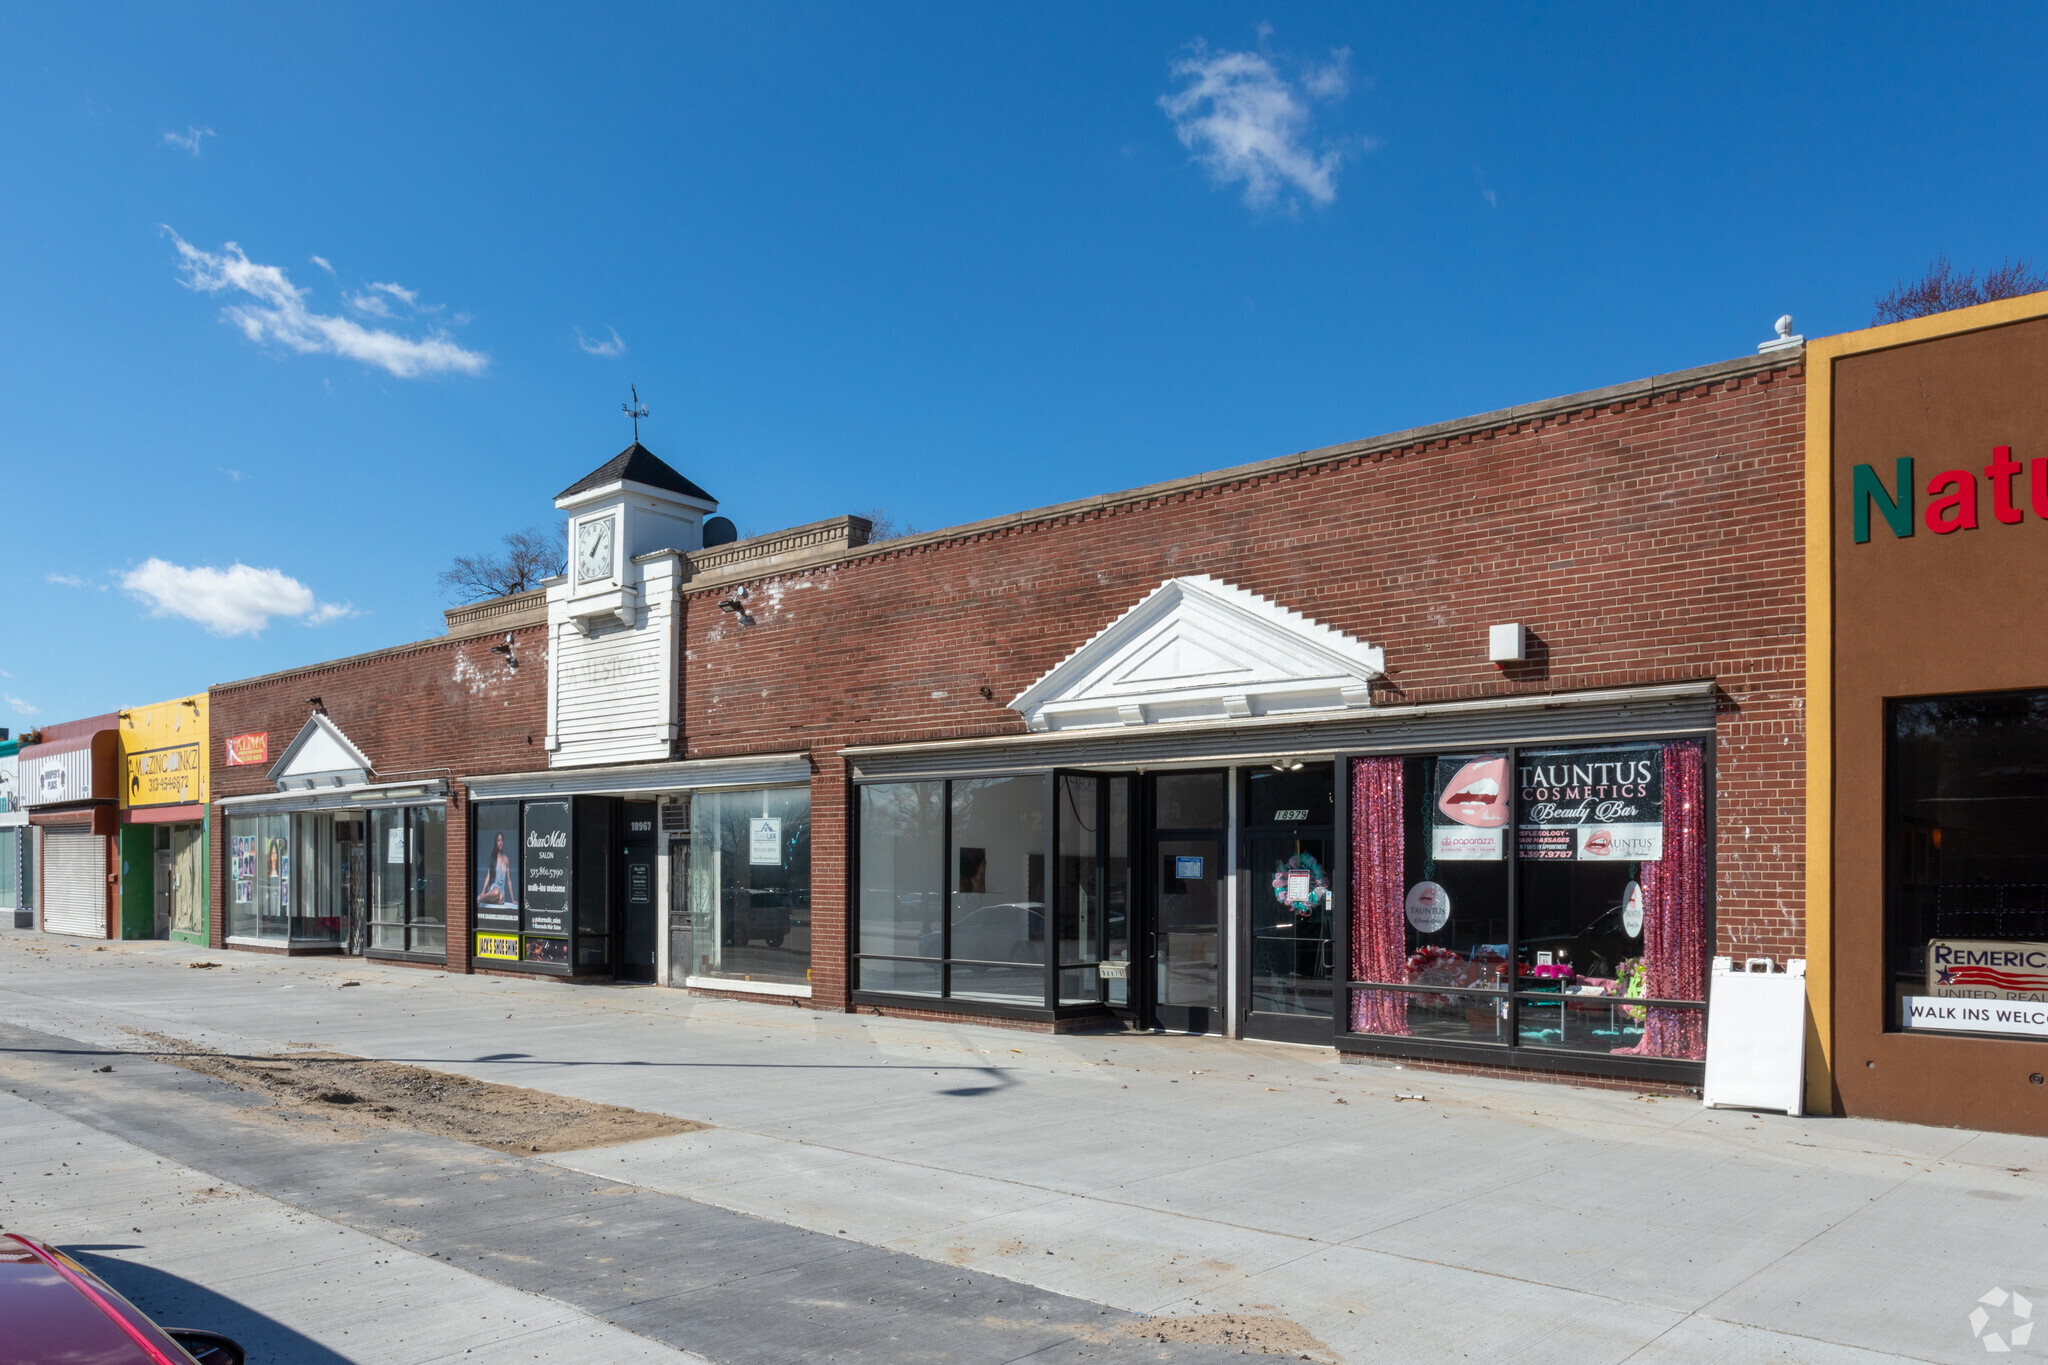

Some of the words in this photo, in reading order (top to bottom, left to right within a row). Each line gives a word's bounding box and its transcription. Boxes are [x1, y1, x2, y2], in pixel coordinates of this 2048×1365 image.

[1520, 761, 1651, 788] TAUNTUS
[1522, 784, 1646, 801] COSMETICS
[1278, 811, 1307, 820] 18979
[1530, 797, 1599, 826] Beauty
[1594, 801, 1638, 823] Bar
[631, 822, 651, 831] 18967
[1600, 838, 1652, 848] TAUNTUS
[547, 884, 566, 893] welcome
[1411, 907, 1446, 915] TAUNTUS
[1935, 945, 2048, 968] REMERIC
[1909, 1006, 1956, 1020] WALK
[1963, 1008, 1990, 1021] INS
[1997, 1010, 2048, 1025] WELC
